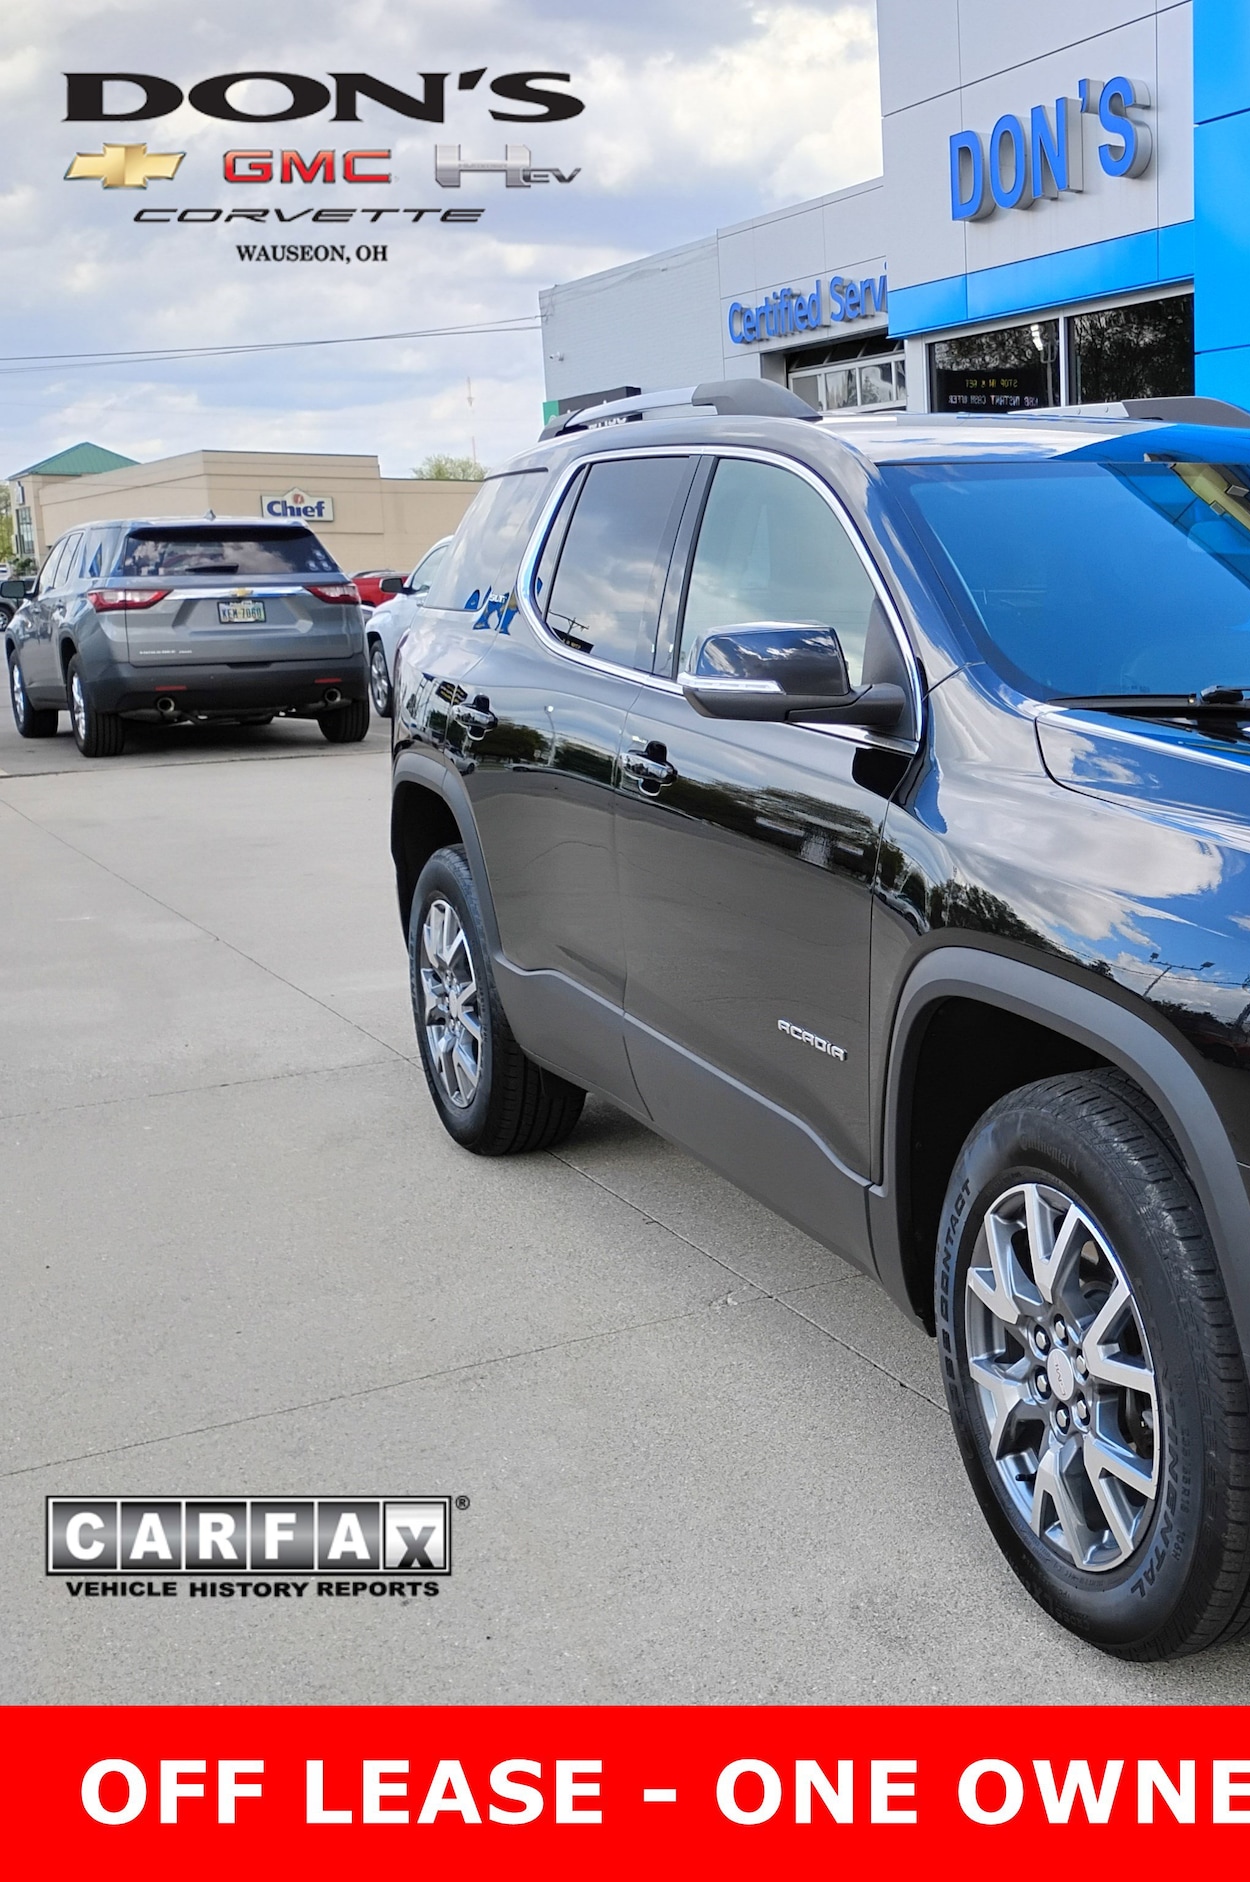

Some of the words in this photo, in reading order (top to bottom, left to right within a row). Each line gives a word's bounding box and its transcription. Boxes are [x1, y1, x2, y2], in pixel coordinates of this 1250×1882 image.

[949, 76, 1152, 222] DON'S
[729, 280, 822, 344] Certified
[830, 262, 888, 323] Serv
[267, 500, 325, 517] Chief
[776, 1017, 848, 1062] ACADIA
